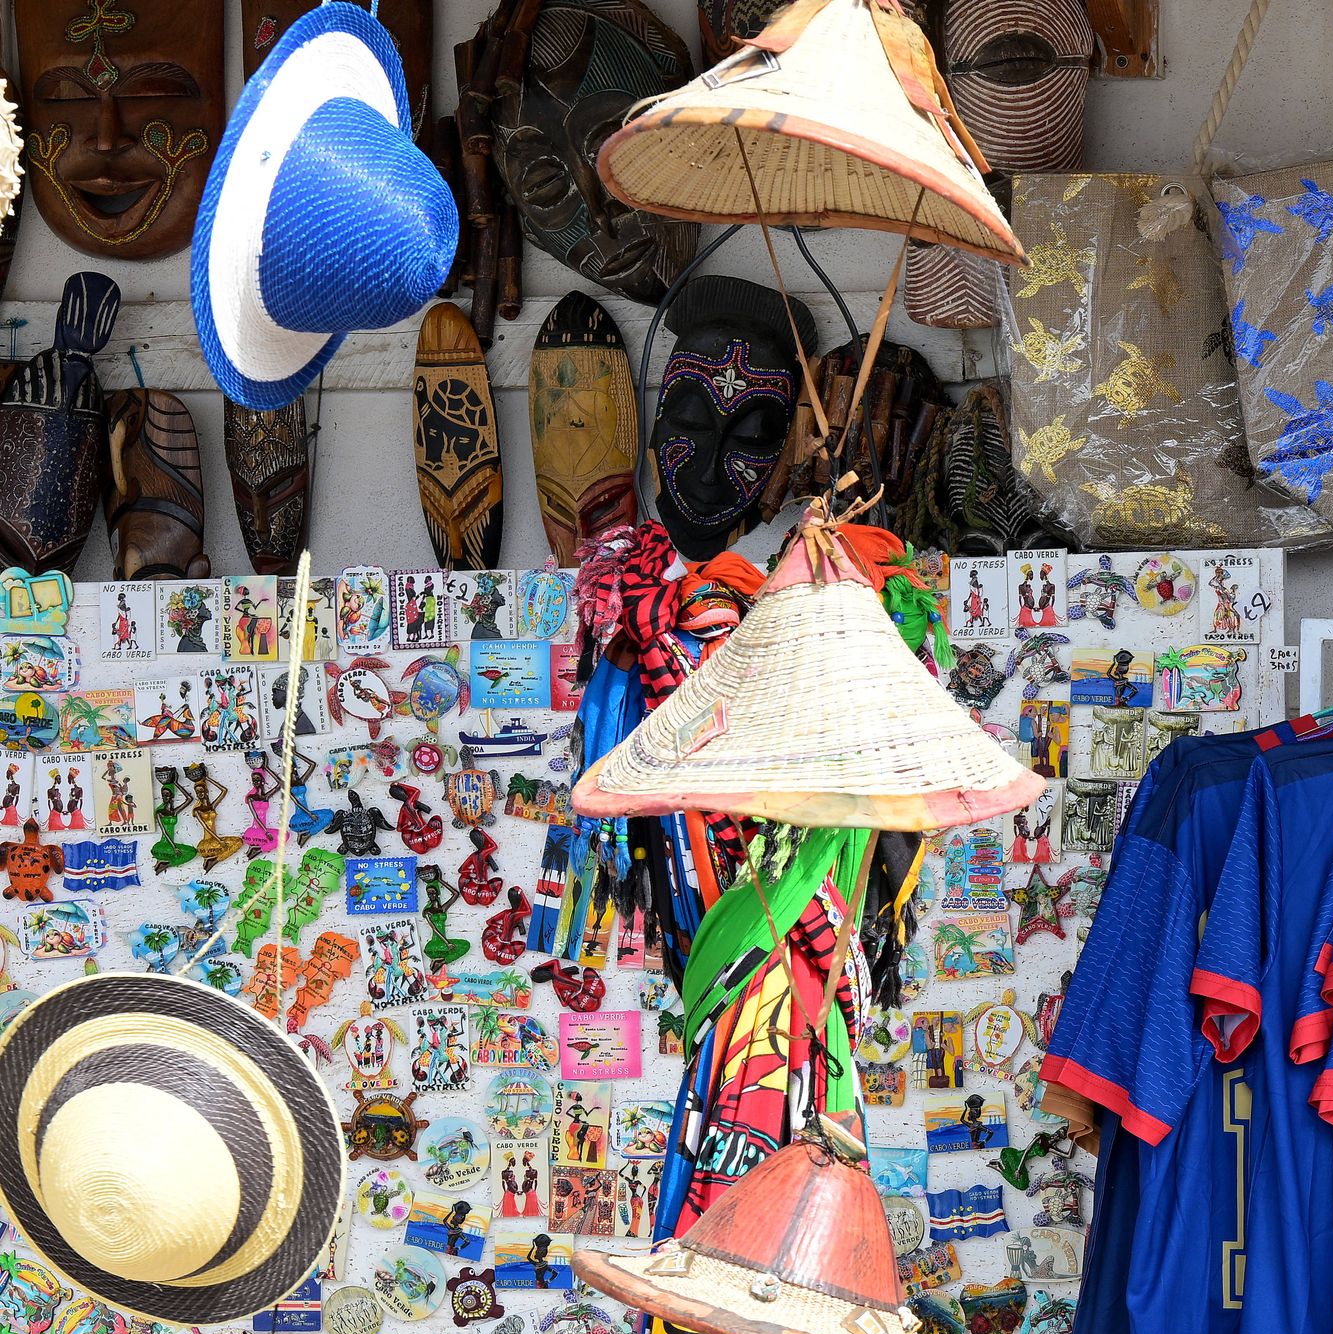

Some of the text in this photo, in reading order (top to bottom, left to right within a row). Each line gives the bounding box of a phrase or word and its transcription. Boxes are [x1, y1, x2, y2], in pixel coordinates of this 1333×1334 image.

[1036, 551, 1059, 559] VERDE
[954, 560, 1005, 569] NO STRESS
[102, 583, 153, 592] NO STRESS
[446, 579, 467, 602] €2
[1243, 592, 1271, 621] €2
[222, 578, 234, 657] CABO VERDE
[397, 599, 406, 628] VERDE
[952, 627, 1005, 637] CABO VERDE
[101, 650, 151, 659] CABO VERDE
[200, 667, 251, 678] CABO VERDE
[1072, 695, 1091, 703] CABO
[204, 741, 256, 752] NO STRESS
[42, 755, 85, 764] CABO VERDE
[95, 751, 143, 760] NO STRESS
[99, 824, 149, 834] CABO VERDE
[360, 920, 411, 936] CABO VERDE
[412, 1007, 464, 1016] CABO VERDE
[471, 1049, 526, 1064] CABO VERDE
[550, 1083, 565, 1161] CABO VERDE
[949, 1141, 969, 1150] VERDE
